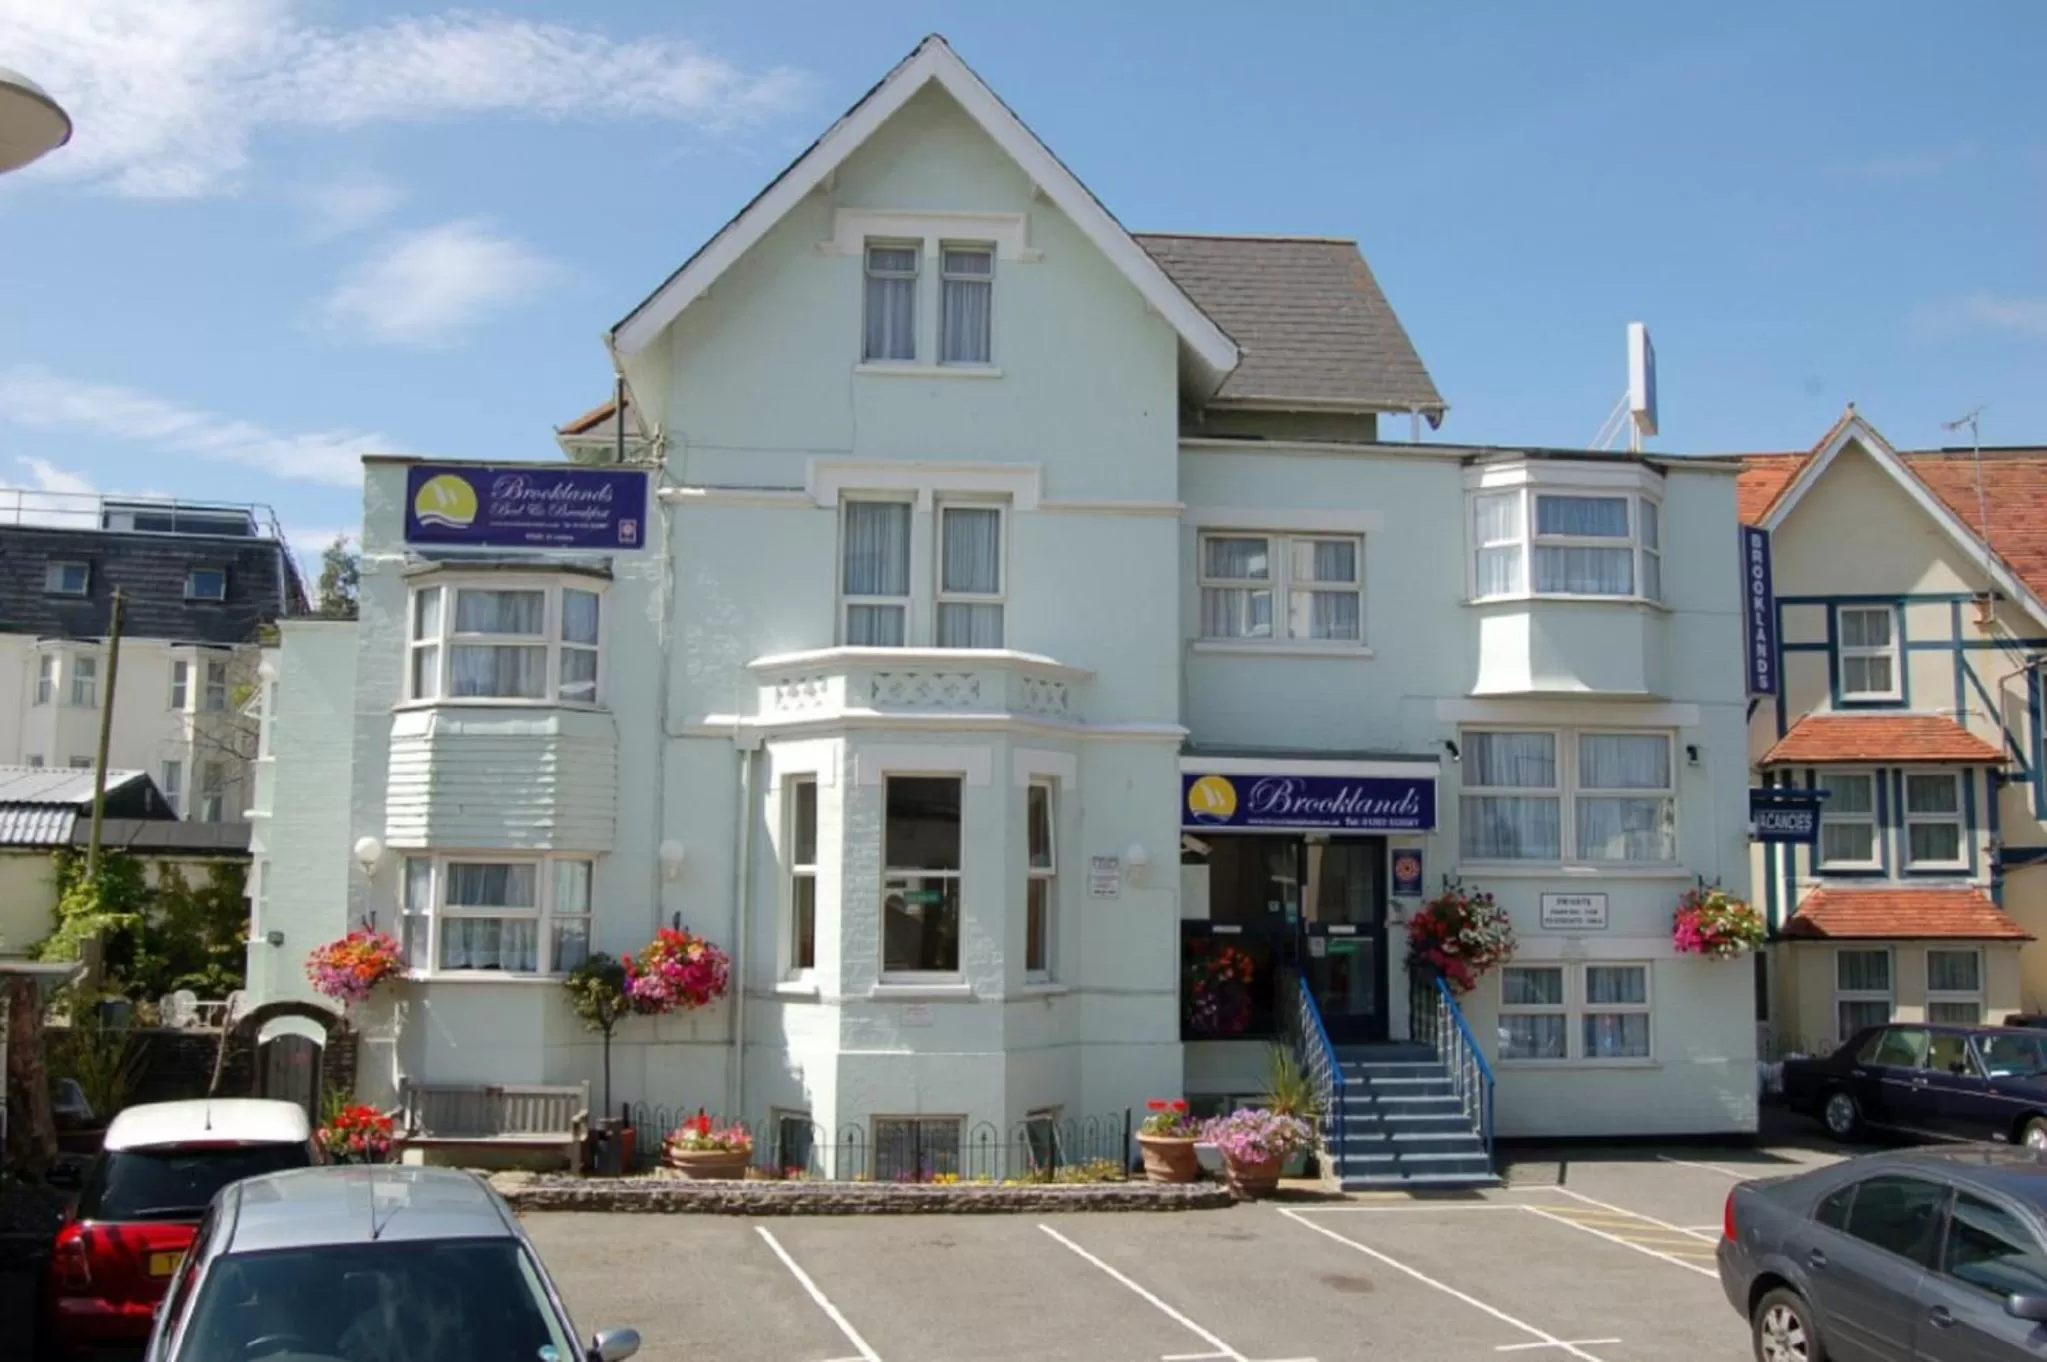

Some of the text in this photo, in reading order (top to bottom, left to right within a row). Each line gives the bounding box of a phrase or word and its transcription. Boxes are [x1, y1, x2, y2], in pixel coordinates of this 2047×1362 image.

[491, 473, 613, 502] Brooklands
[1751, 533, 1768, 690] BROOKLANDS
[1248, 775, 1420, 815] Brooklands
